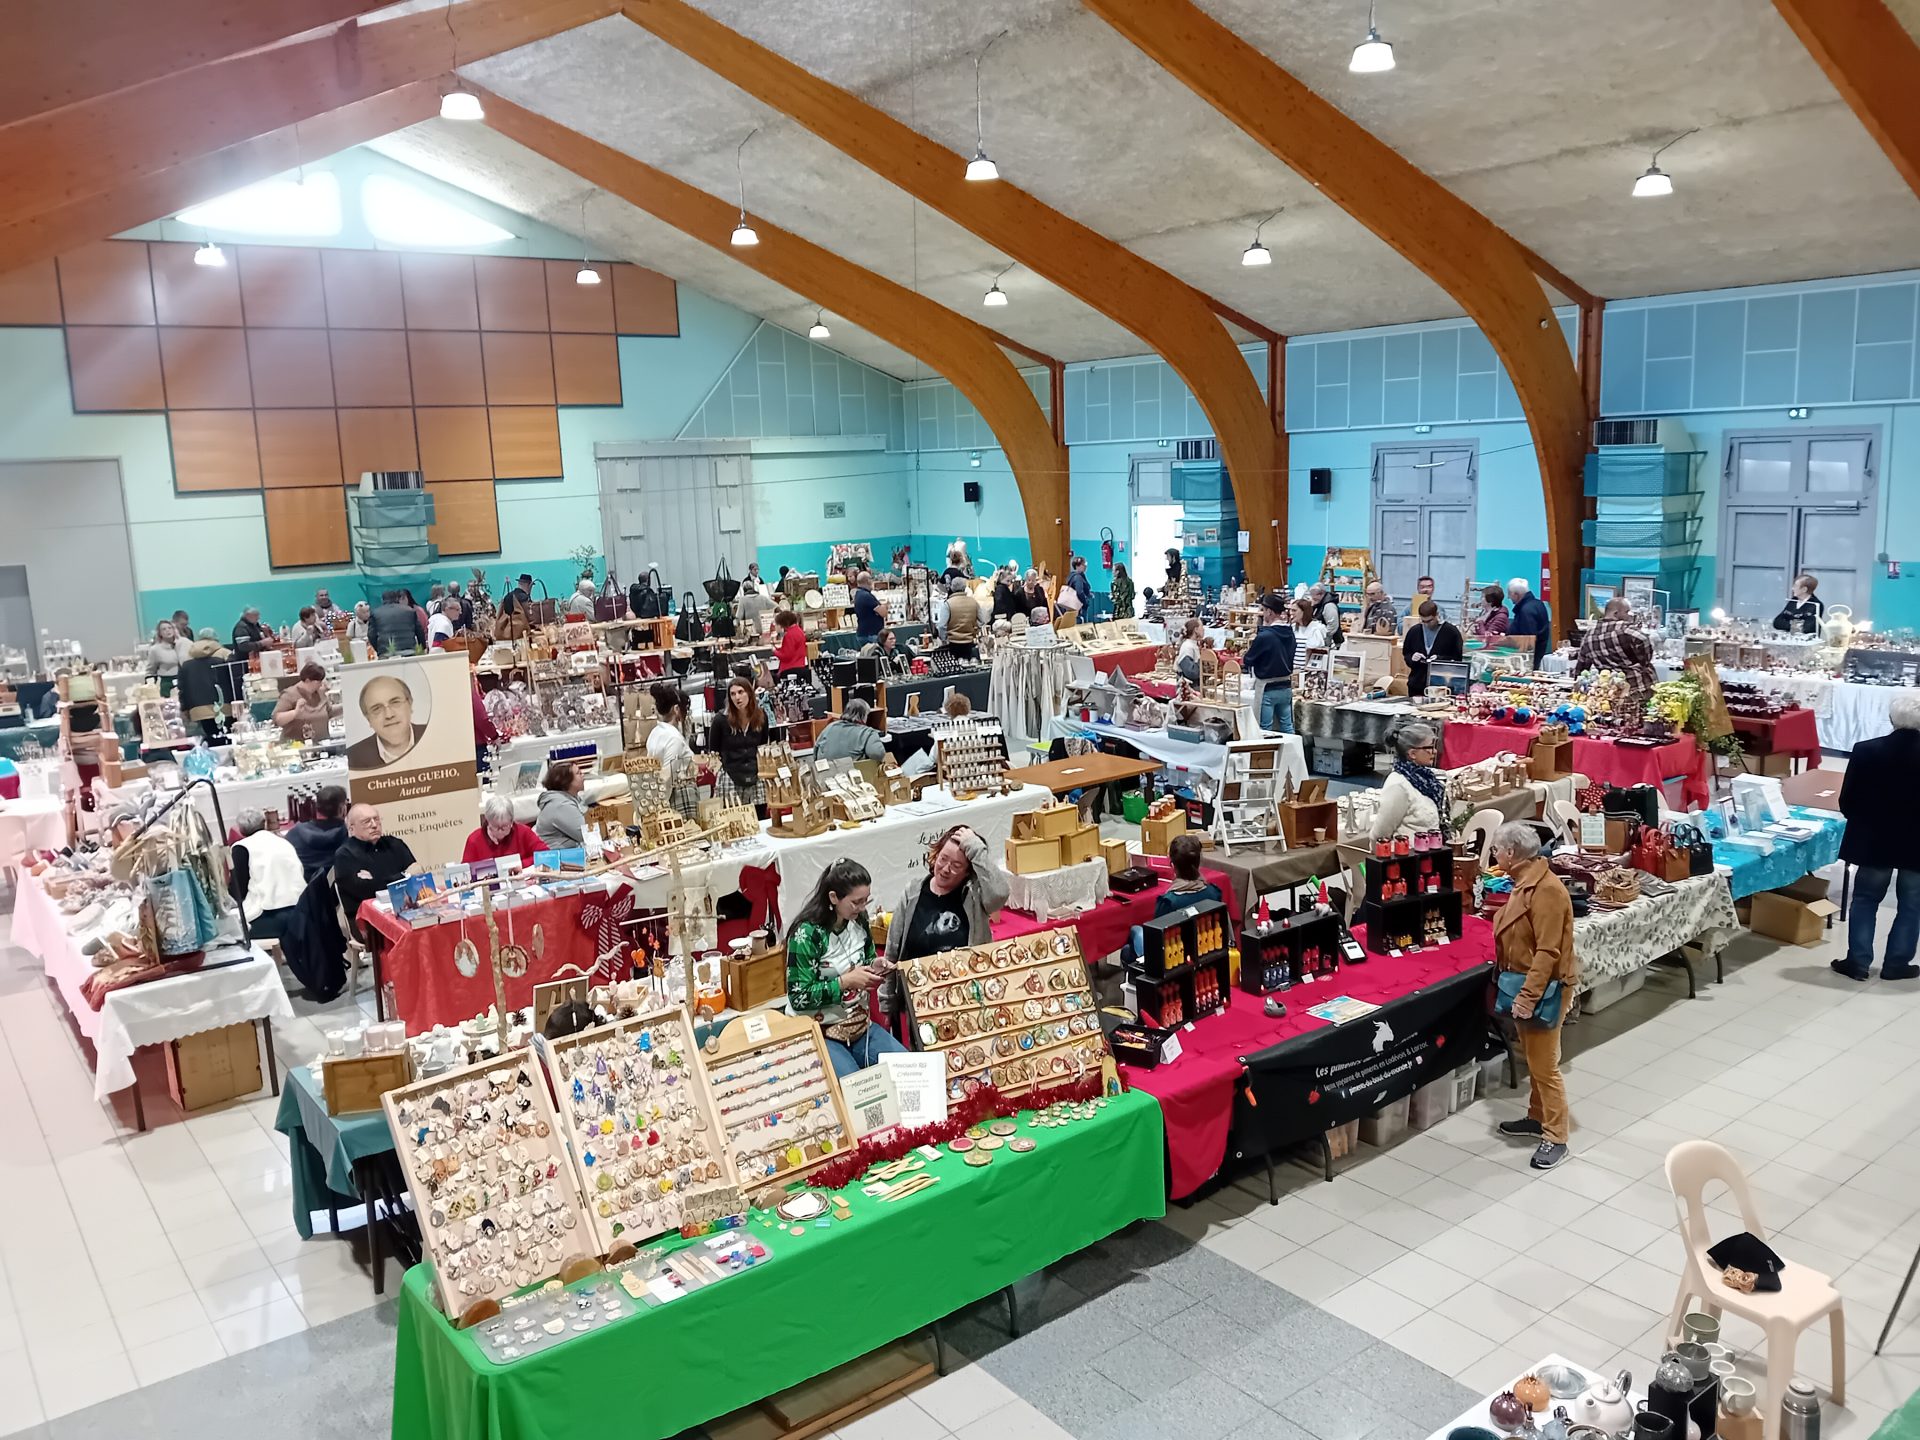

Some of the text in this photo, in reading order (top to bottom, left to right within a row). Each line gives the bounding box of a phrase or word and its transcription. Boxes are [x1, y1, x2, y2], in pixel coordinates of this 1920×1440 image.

[367, 768, 460, 791] Christian GUEHO.
[400, 785, 432, 797] Auteur
[397, 810, 437, 822] Romans
[419, 818, 463, 832] Enquêtes
[1354, 1071, 1362, 1079] de
[1361, 1063, 1379, 1078] piments
[1379, 1060, 1386, 1069] en
[1406, 1048, 1412, 1056] &
[1411, 1041, 1429, 1054] Larzac
[1315, 1066, 1329, 1079] Les
